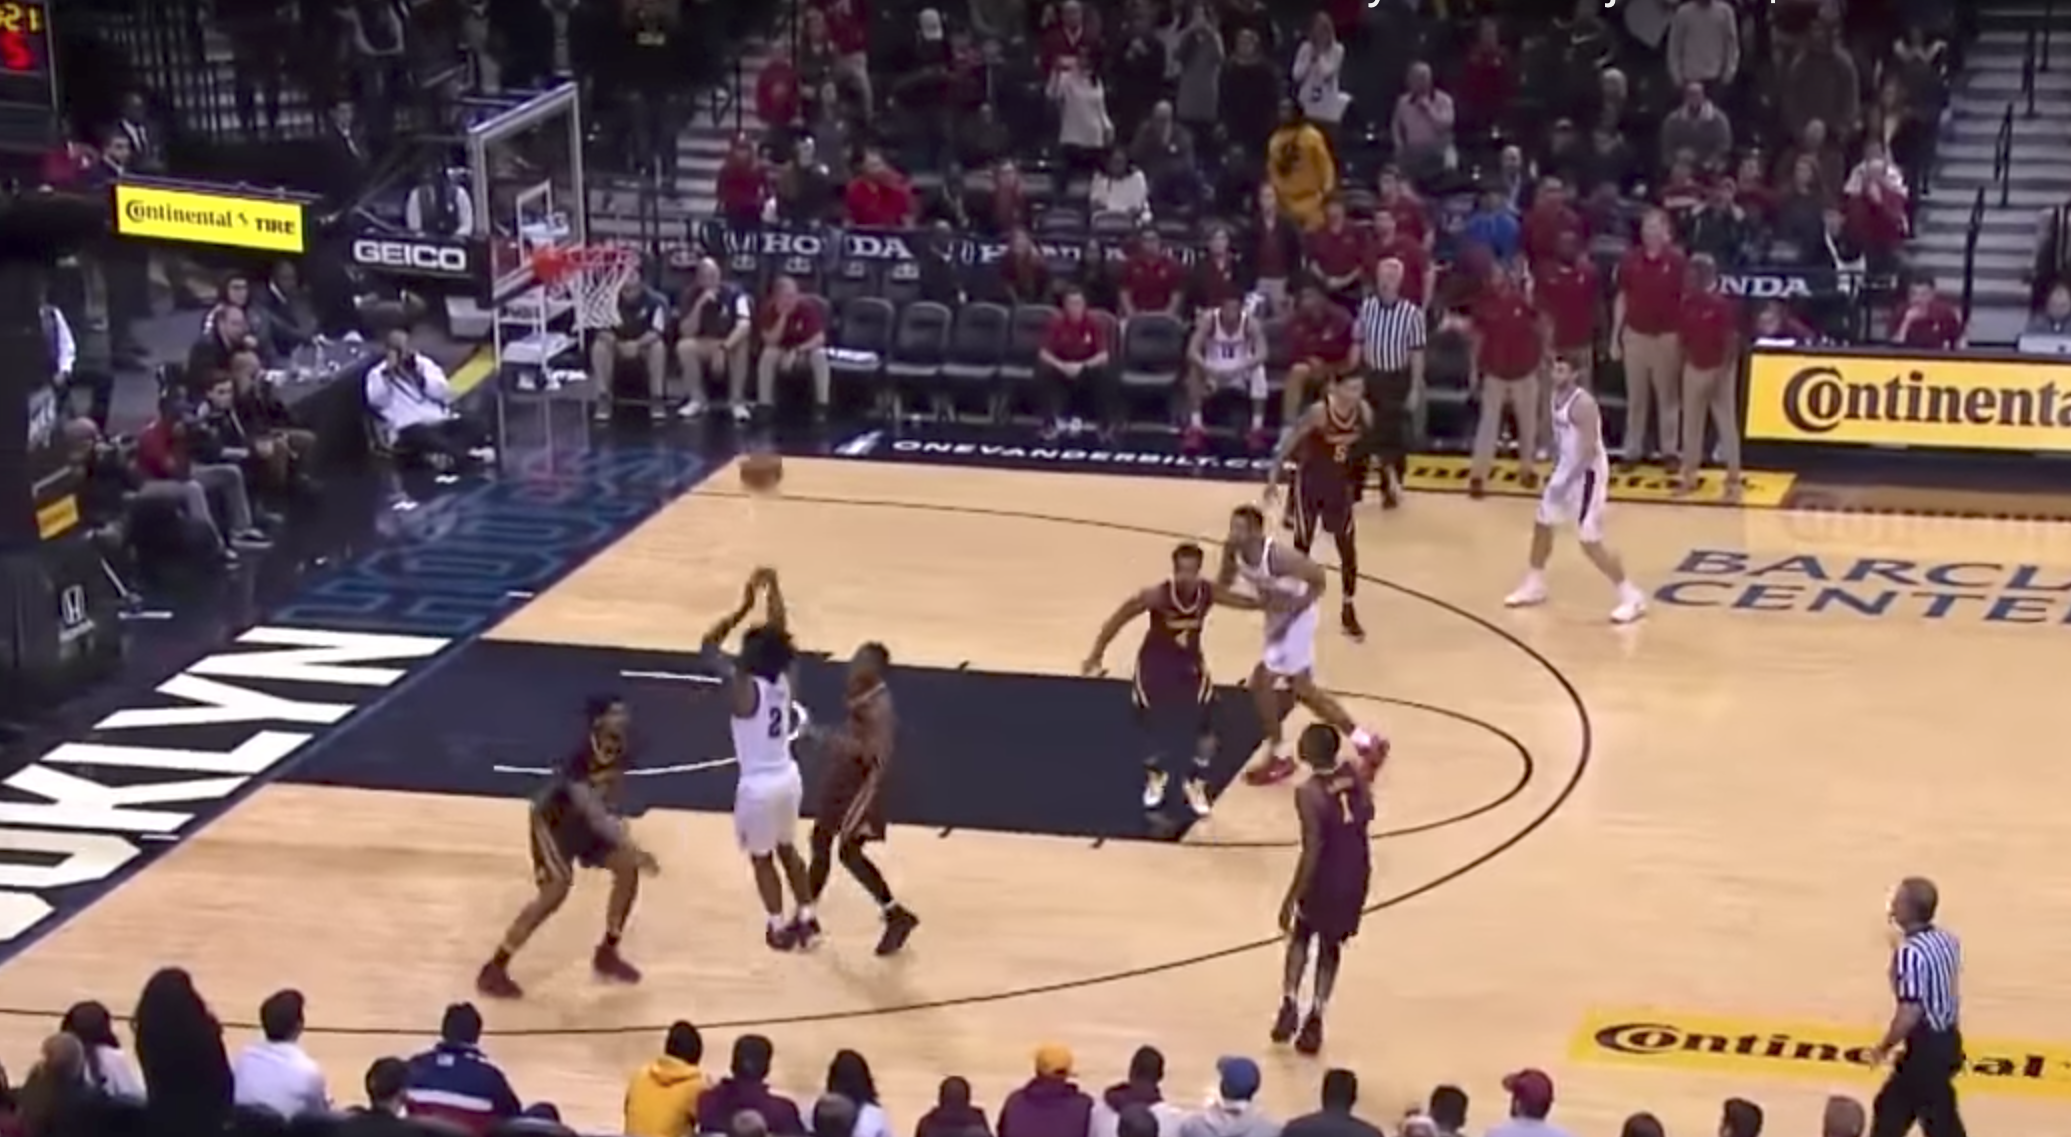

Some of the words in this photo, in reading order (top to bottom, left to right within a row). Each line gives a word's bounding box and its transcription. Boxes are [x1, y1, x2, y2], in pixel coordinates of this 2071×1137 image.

[125, 199, 233, 228] Continental
[255, 216, 297, 235] TIRE
[353, 239, 467, 271] GEICO
[768, 706, 782, 738] 2
[1340, 792, 1354, 824] 1
[1594, 1022, 2047, 1079] Contineal
